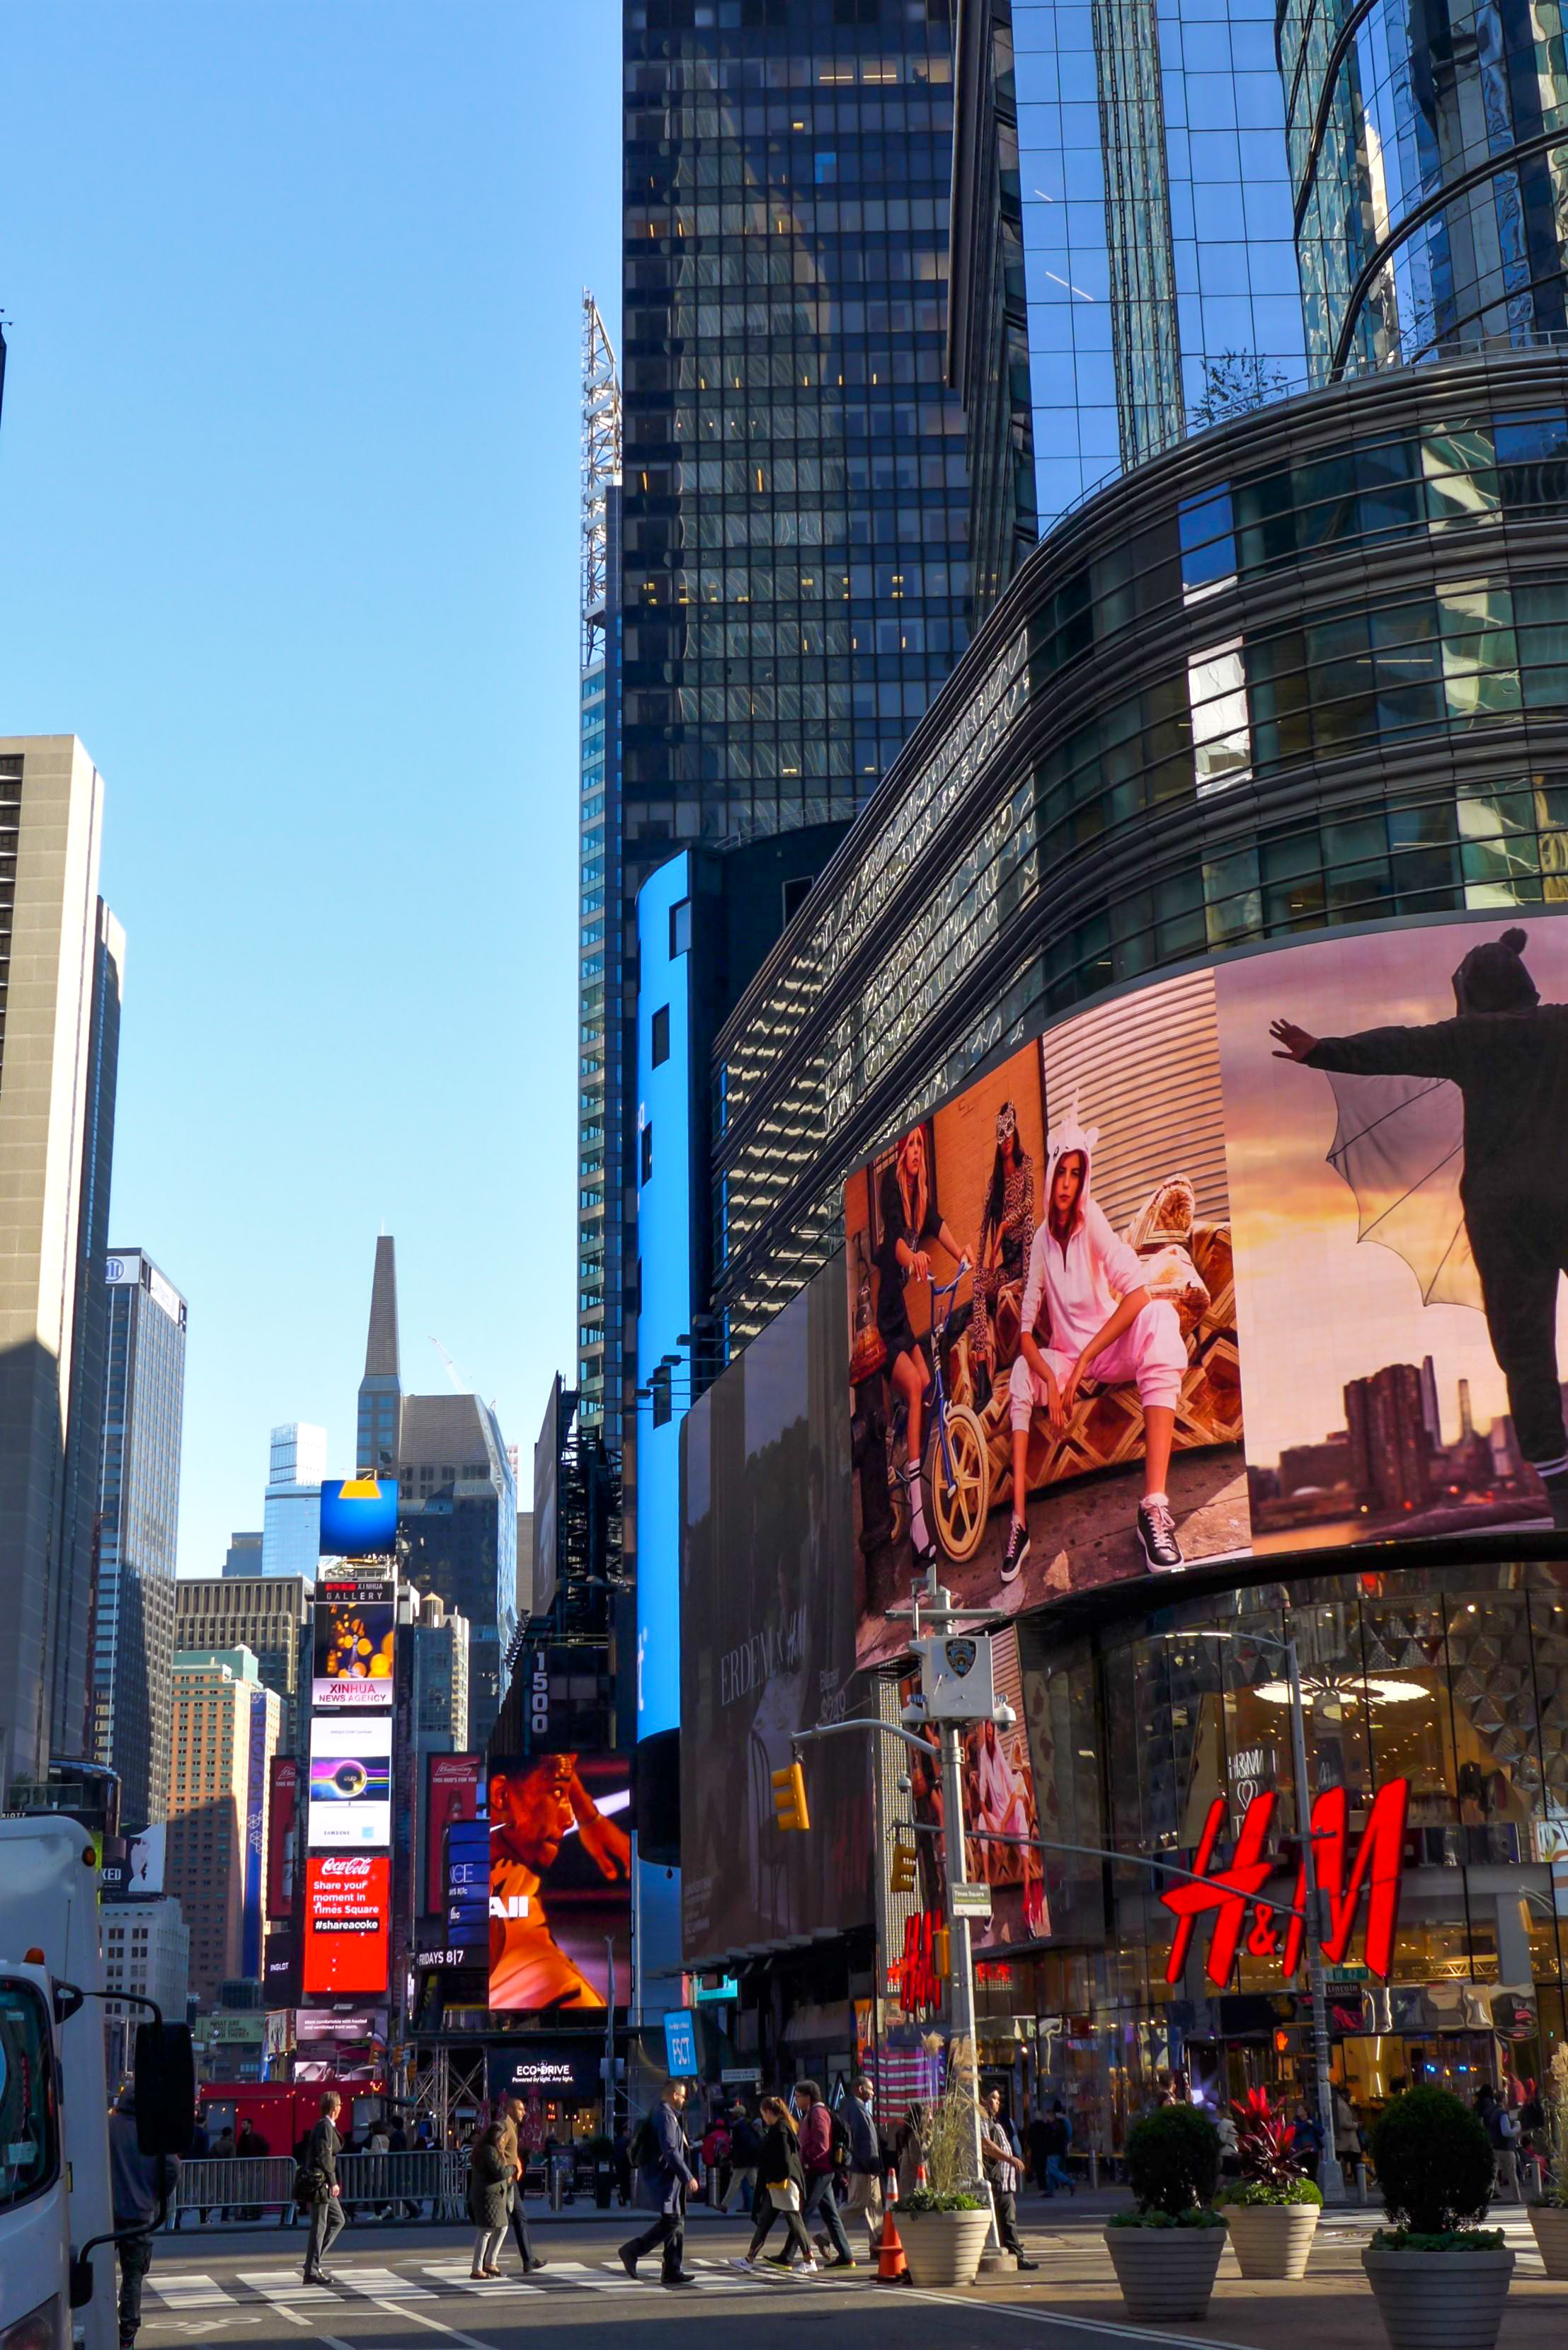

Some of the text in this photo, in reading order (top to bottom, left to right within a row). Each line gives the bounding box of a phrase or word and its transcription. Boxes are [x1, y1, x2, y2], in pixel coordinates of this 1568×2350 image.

[721, 1626, 775, 1706] ERDEM
[330, 1684, 376, 1694] XINHUA
[532, 1652, 549, 1734] 1500
[314, 1881, 341, 1890] Share
[1159, 1777, 1411, 1987] H&M
[314, 1893, 366, 1902] moment in
[314, 1905, 379, 1915] Times Square
[316, 1920, 378, 1929] #shareacoke
